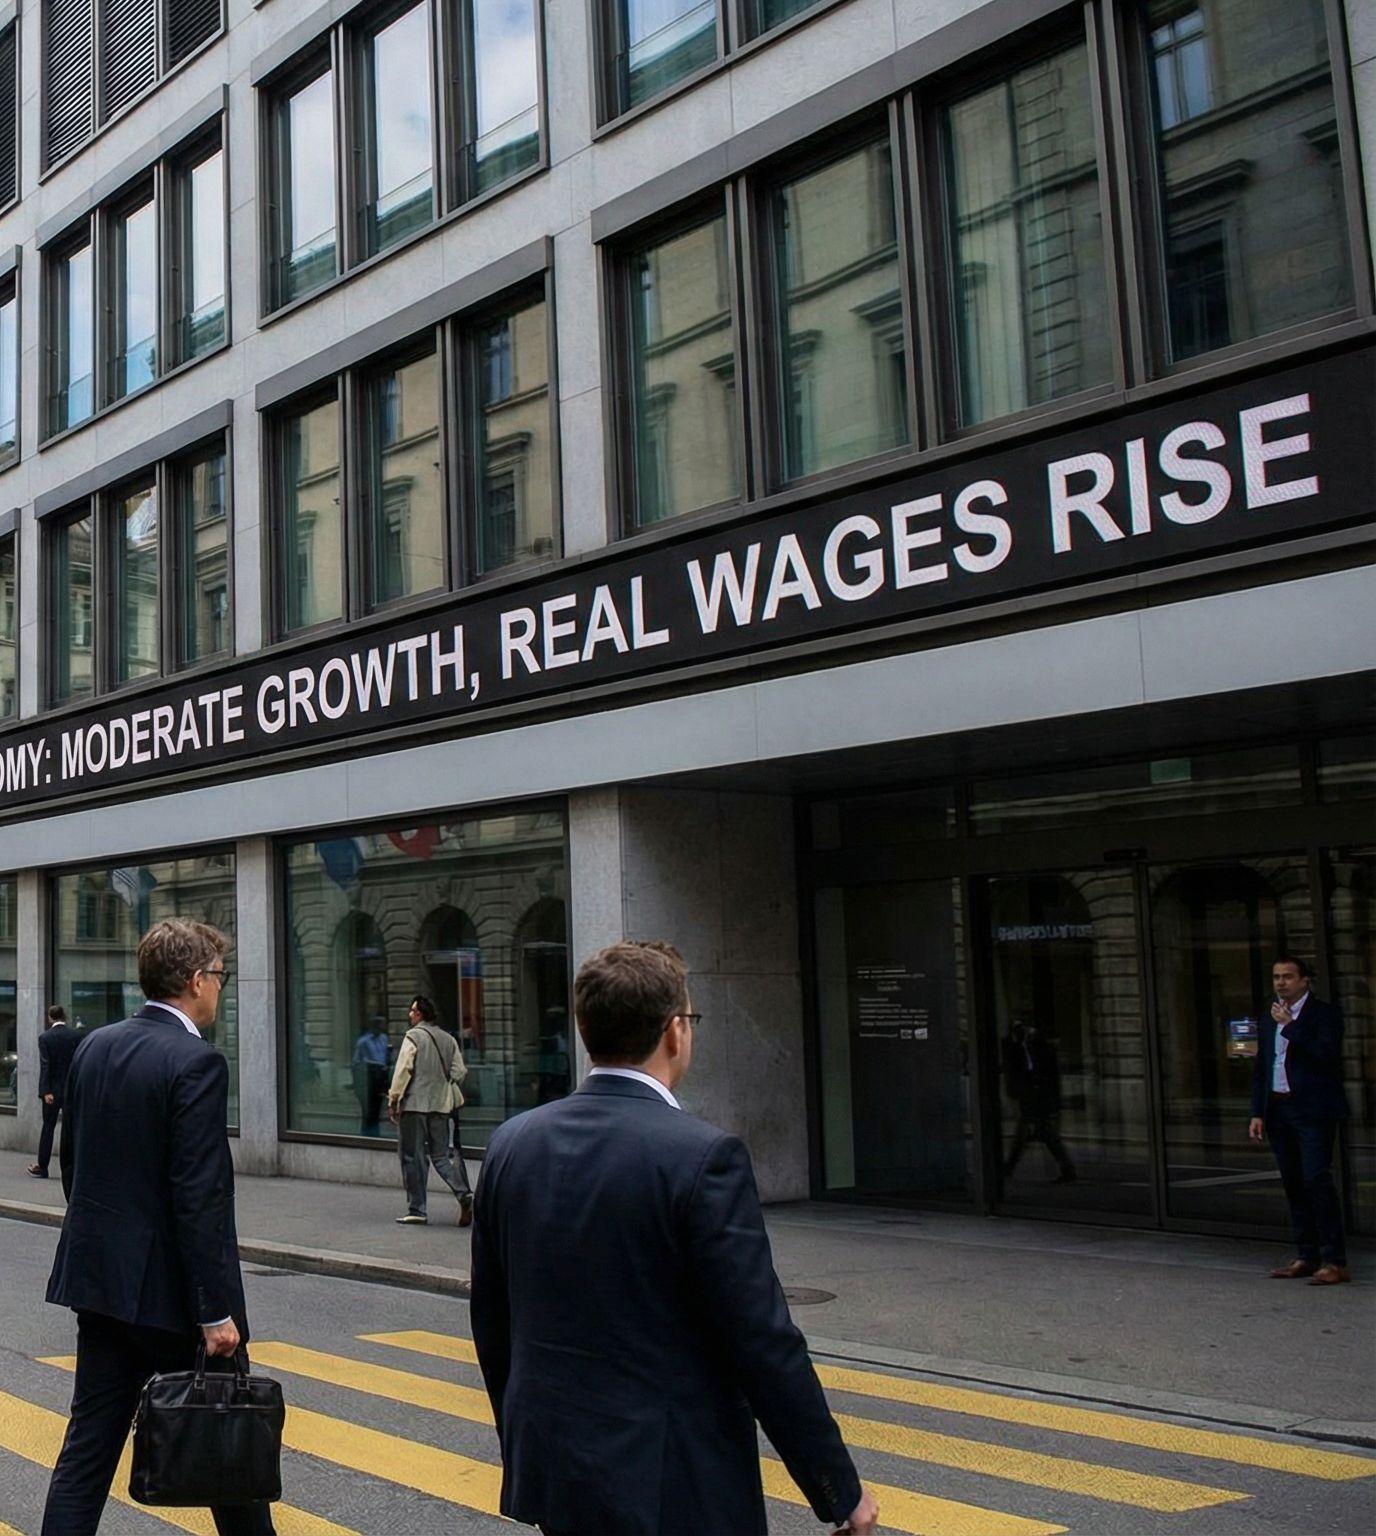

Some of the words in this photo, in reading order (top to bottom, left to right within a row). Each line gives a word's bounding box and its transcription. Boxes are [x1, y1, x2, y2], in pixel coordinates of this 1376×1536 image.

[61, 684, 245, 780] MODERATE
[256, 624, 481, 734] GROWTH,
[500, 575, 670, 680] REAL
[686, 480, 1013, 634] WAGES
[1047, 393, 1319, 554] RISE
